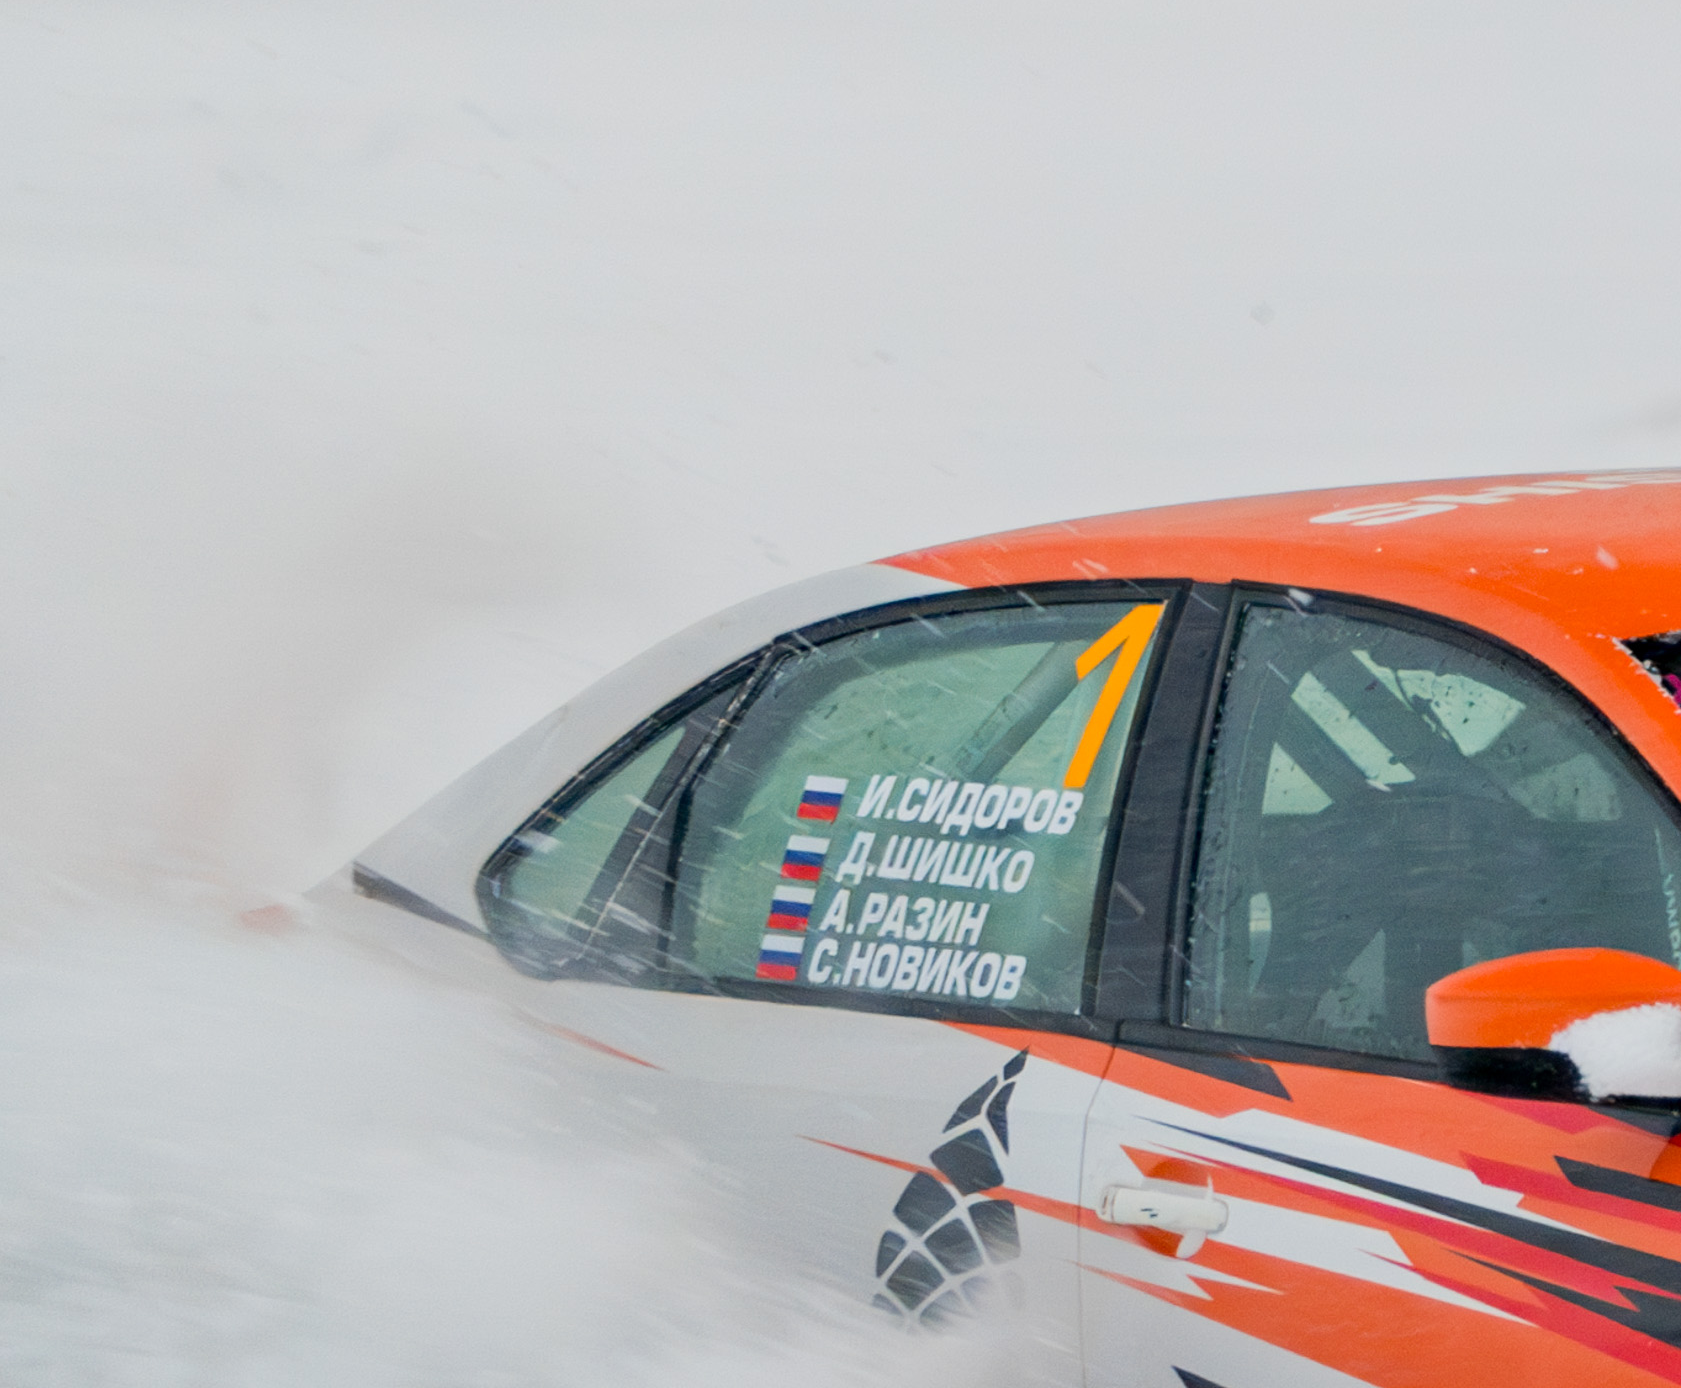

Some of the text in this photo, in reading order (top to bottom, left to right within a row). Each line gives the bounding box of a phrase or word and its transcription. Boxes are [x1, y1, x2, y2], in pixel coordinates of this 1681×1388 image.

[1063, 604, 1166, 788] 1
[856, 774, 1085, 836] И.СИДОРОВ
[834, 830, 1036, 893] Д.ШИШКО
[819, 888, 991, 946] А.РАЗИН
[807, 937, 1028, 1001] С.НОВИКОВ
